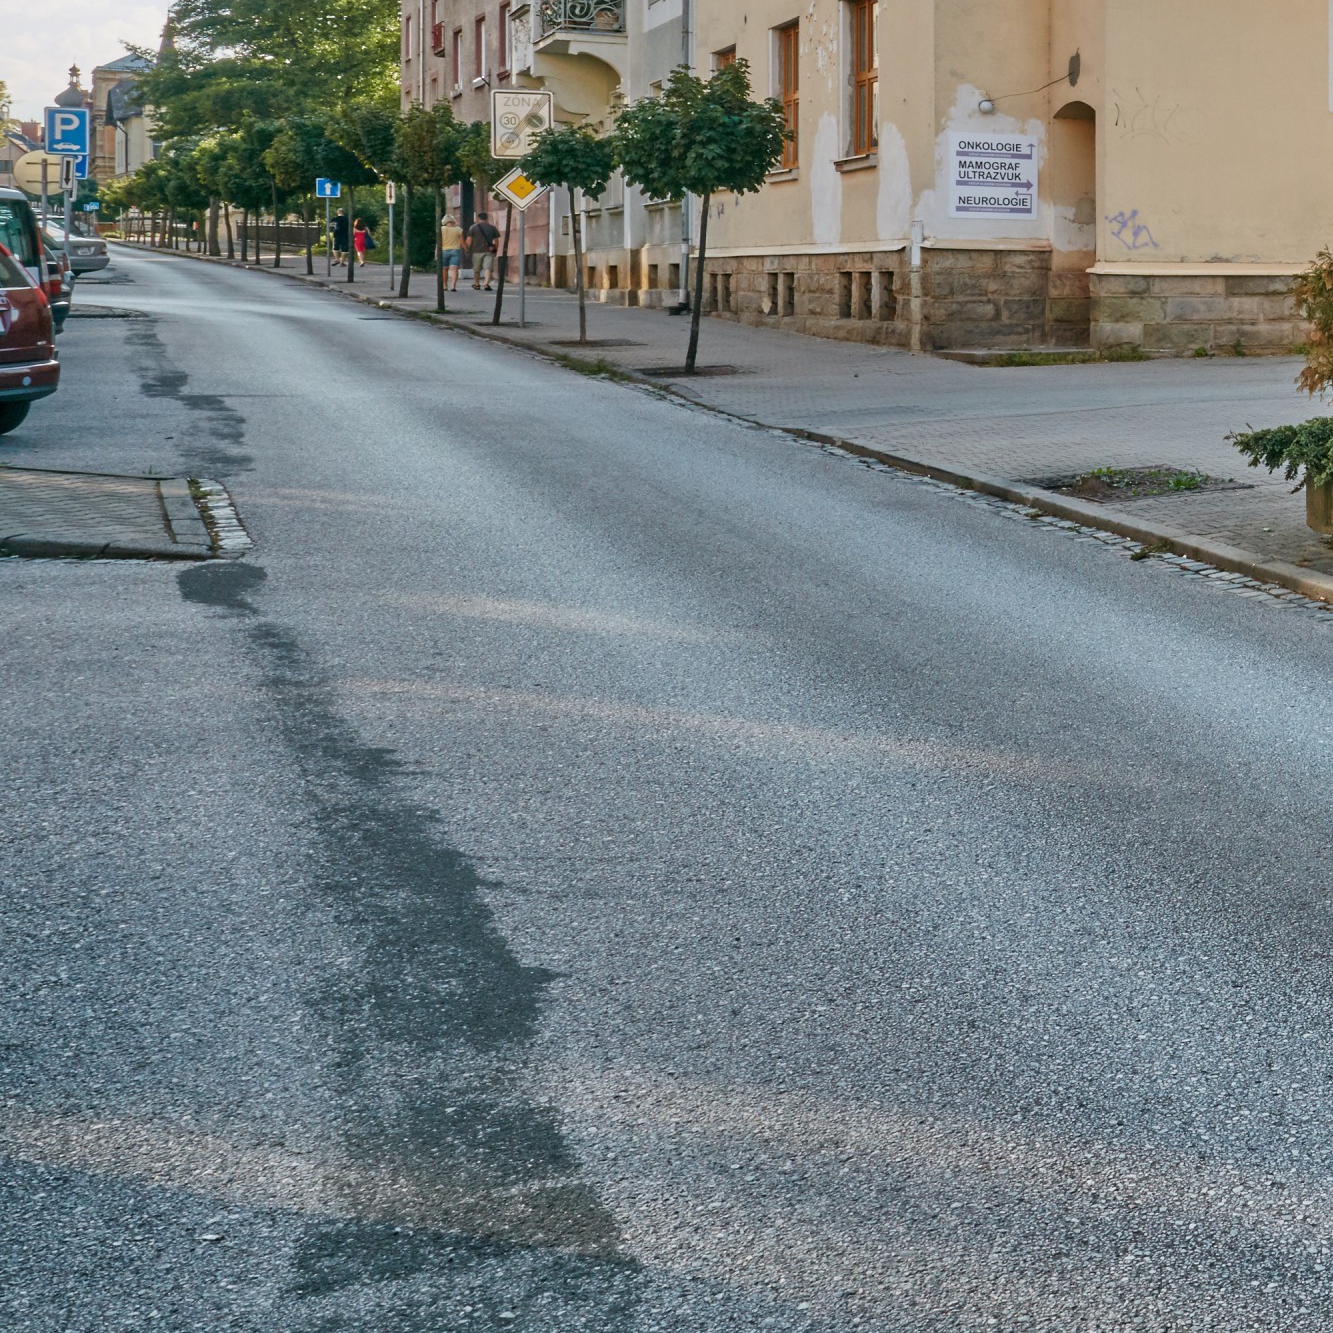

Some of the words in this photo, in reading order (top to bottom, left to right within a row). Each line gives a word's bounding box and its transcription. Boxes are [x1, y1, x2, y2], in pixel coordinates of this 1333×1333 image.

[54, 113, 80, 140] P
[503, 116, 517, 126] 30
[958, 140, 1022, 152] ONKOLOGIE
[958, 160, 1021, 171] MAMOGRAF
[958, 170, 1022, 181] ULTRAZVUK
[958, 196, 1029, 207] NEUROLOGIE
